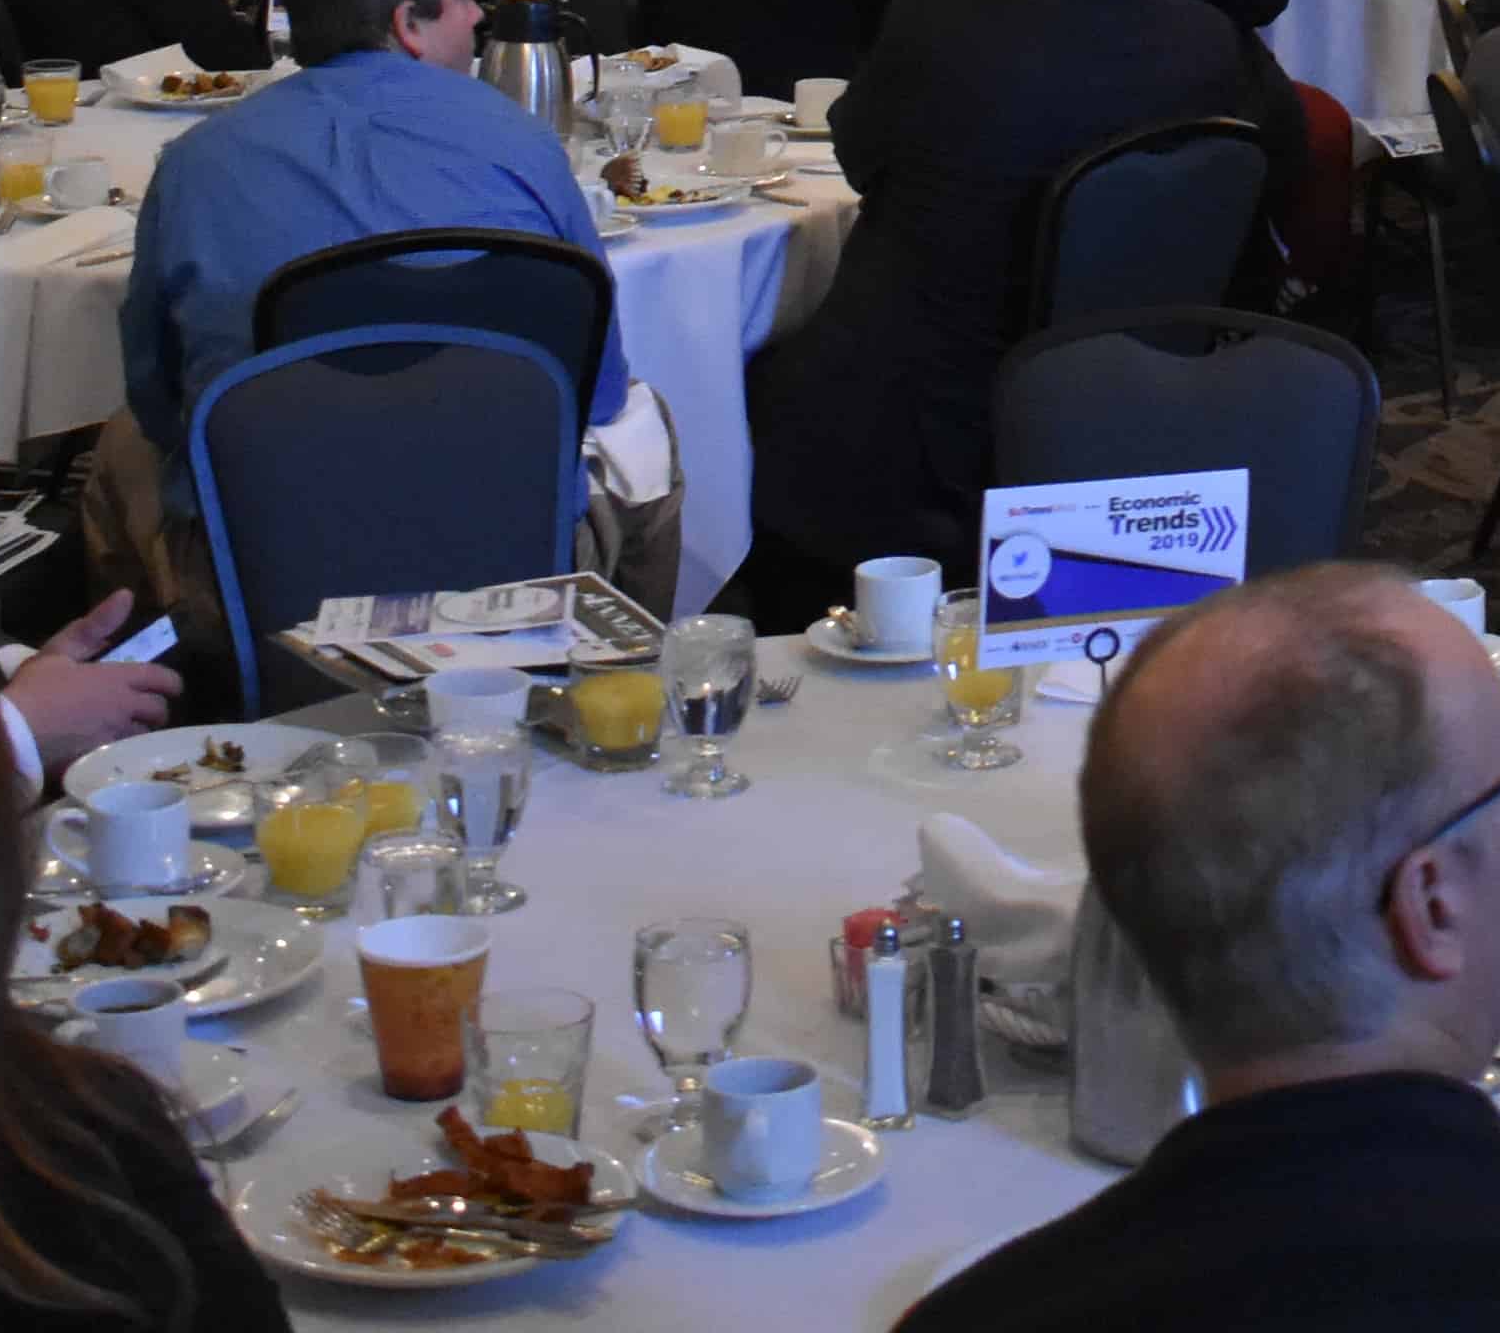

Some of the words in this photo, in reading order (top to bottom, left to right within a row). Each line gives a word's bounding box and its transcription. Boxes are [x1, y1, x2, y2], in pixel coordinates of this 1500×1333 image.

[1108, 490, 1203, 513] Economic
[1108, 508, 1201, 537] Trends
[1149, 533, 1200, 552] 2019
